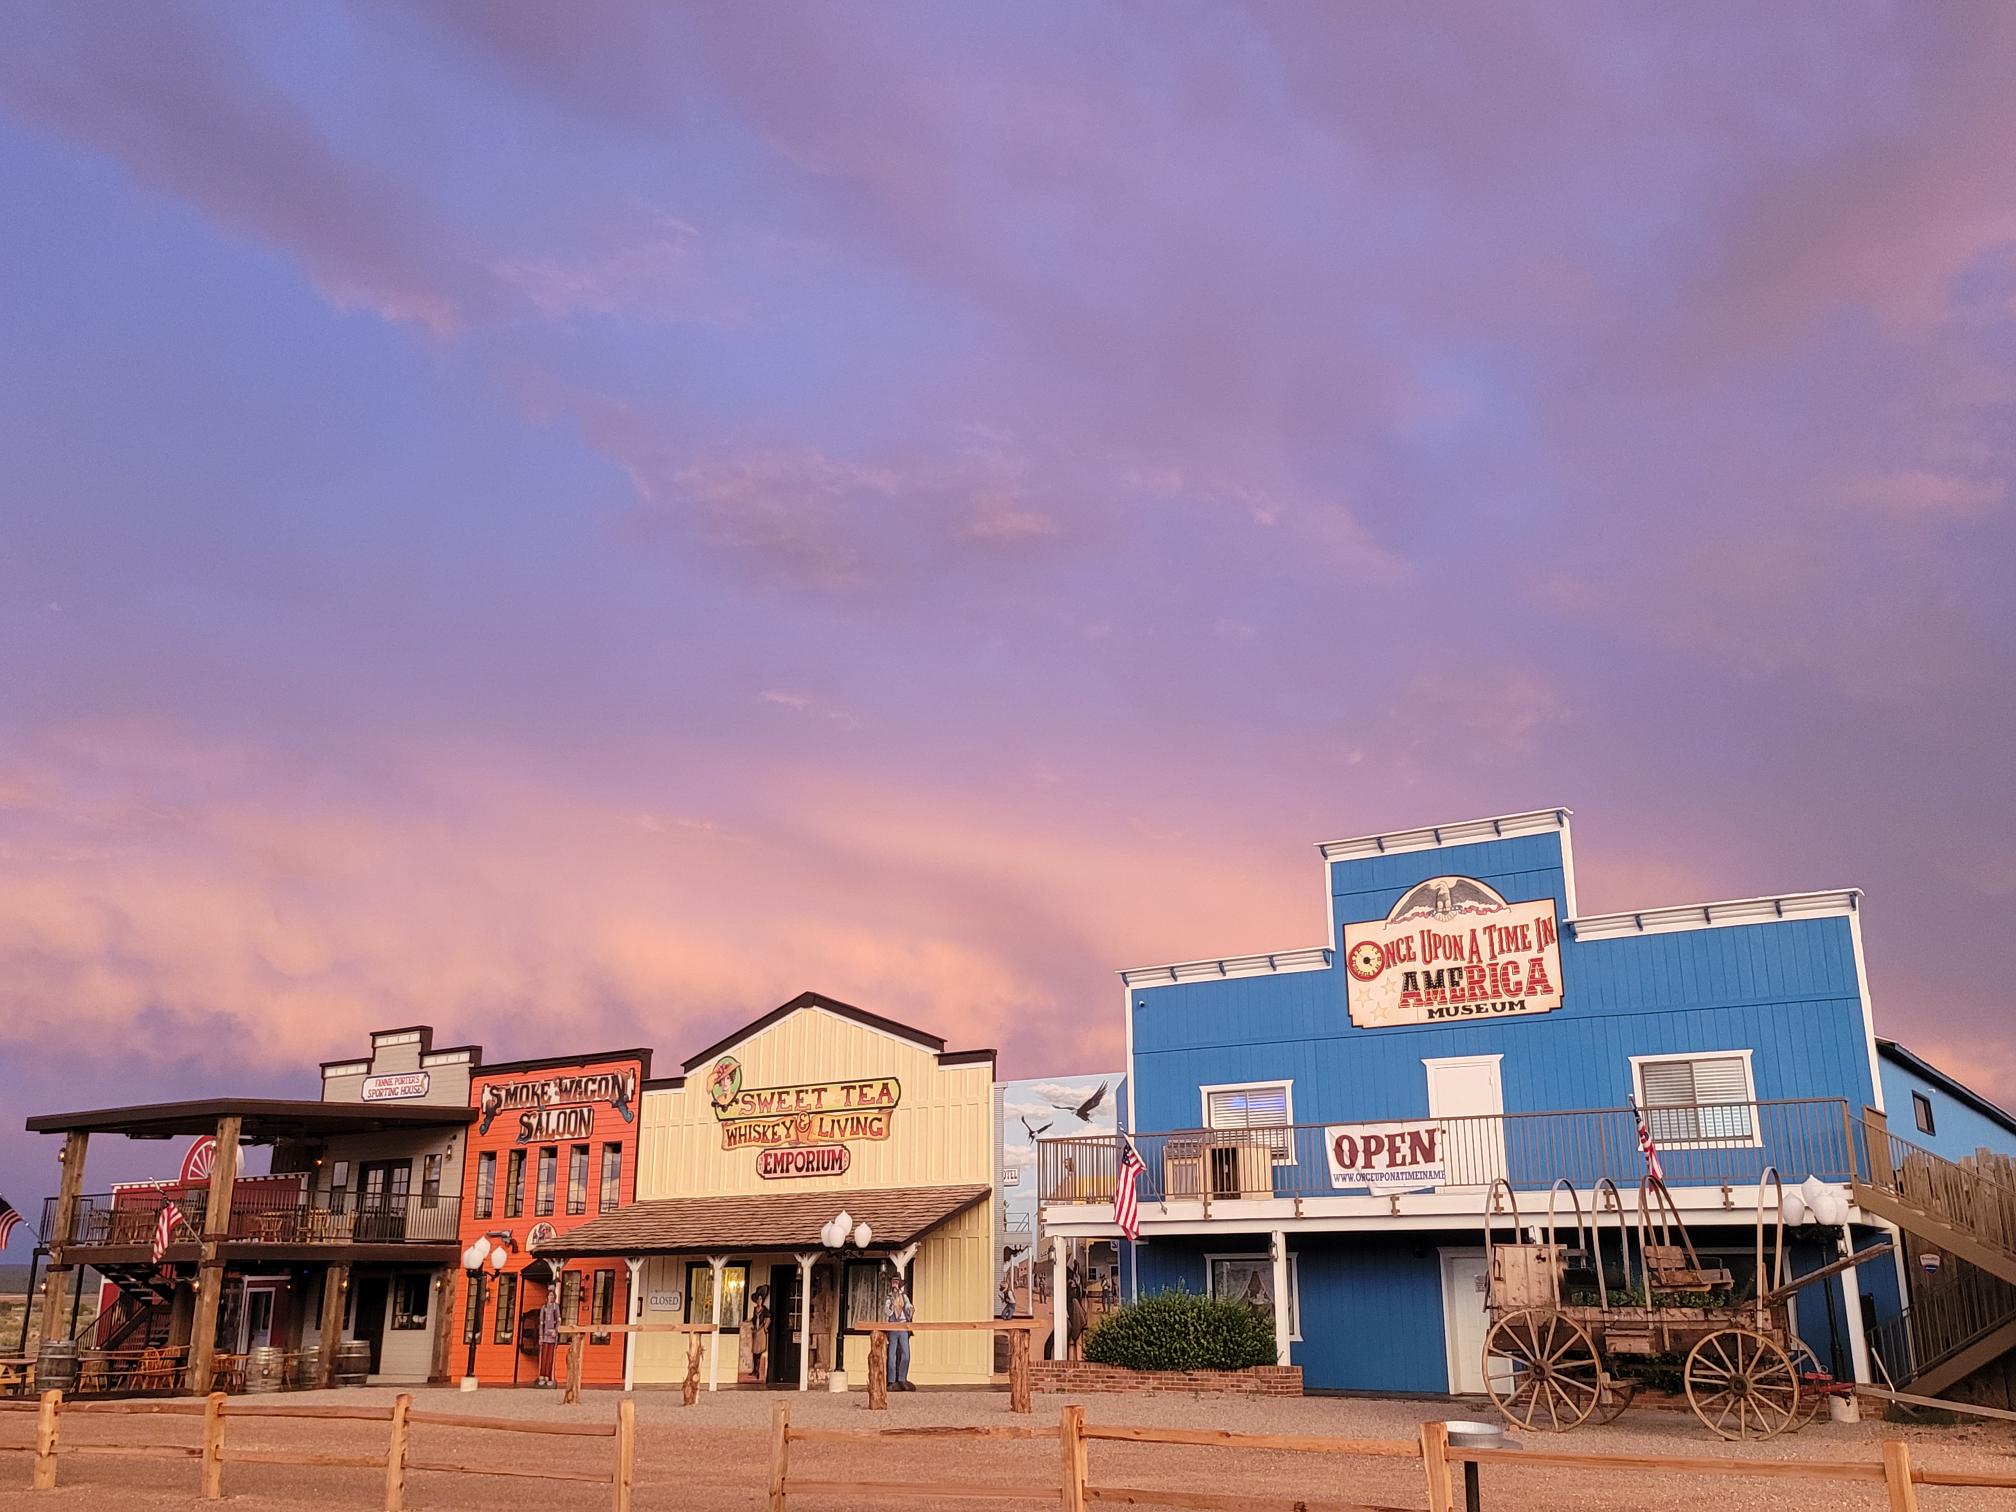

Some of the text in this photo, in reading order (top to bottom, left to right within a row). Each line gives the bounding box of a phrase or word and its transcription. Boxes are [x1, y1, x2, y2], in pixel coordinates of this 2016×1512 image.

[1467, 928, 1484, 964] A
[1398, 957, 1554, 1008] AMERICA
[1427, 1000, 1527, 1019] MUSEUM
[367, 1087, 400, 1098] SPORTING
[489, 1070, 631, 1109] SMOKE WAGON
[739, 1082, 895, 1115] SWEET TEA
[517, 1108, 593, 1143] SALOON
[725, 1113, 884, 1147] WHISKEY & LIVING
[763, 1149, 844, 1174] EMPORIUM
[1333, 1128, 1437, 1169] OPEN
[650, 1296, 678, 1305] CLOSED
